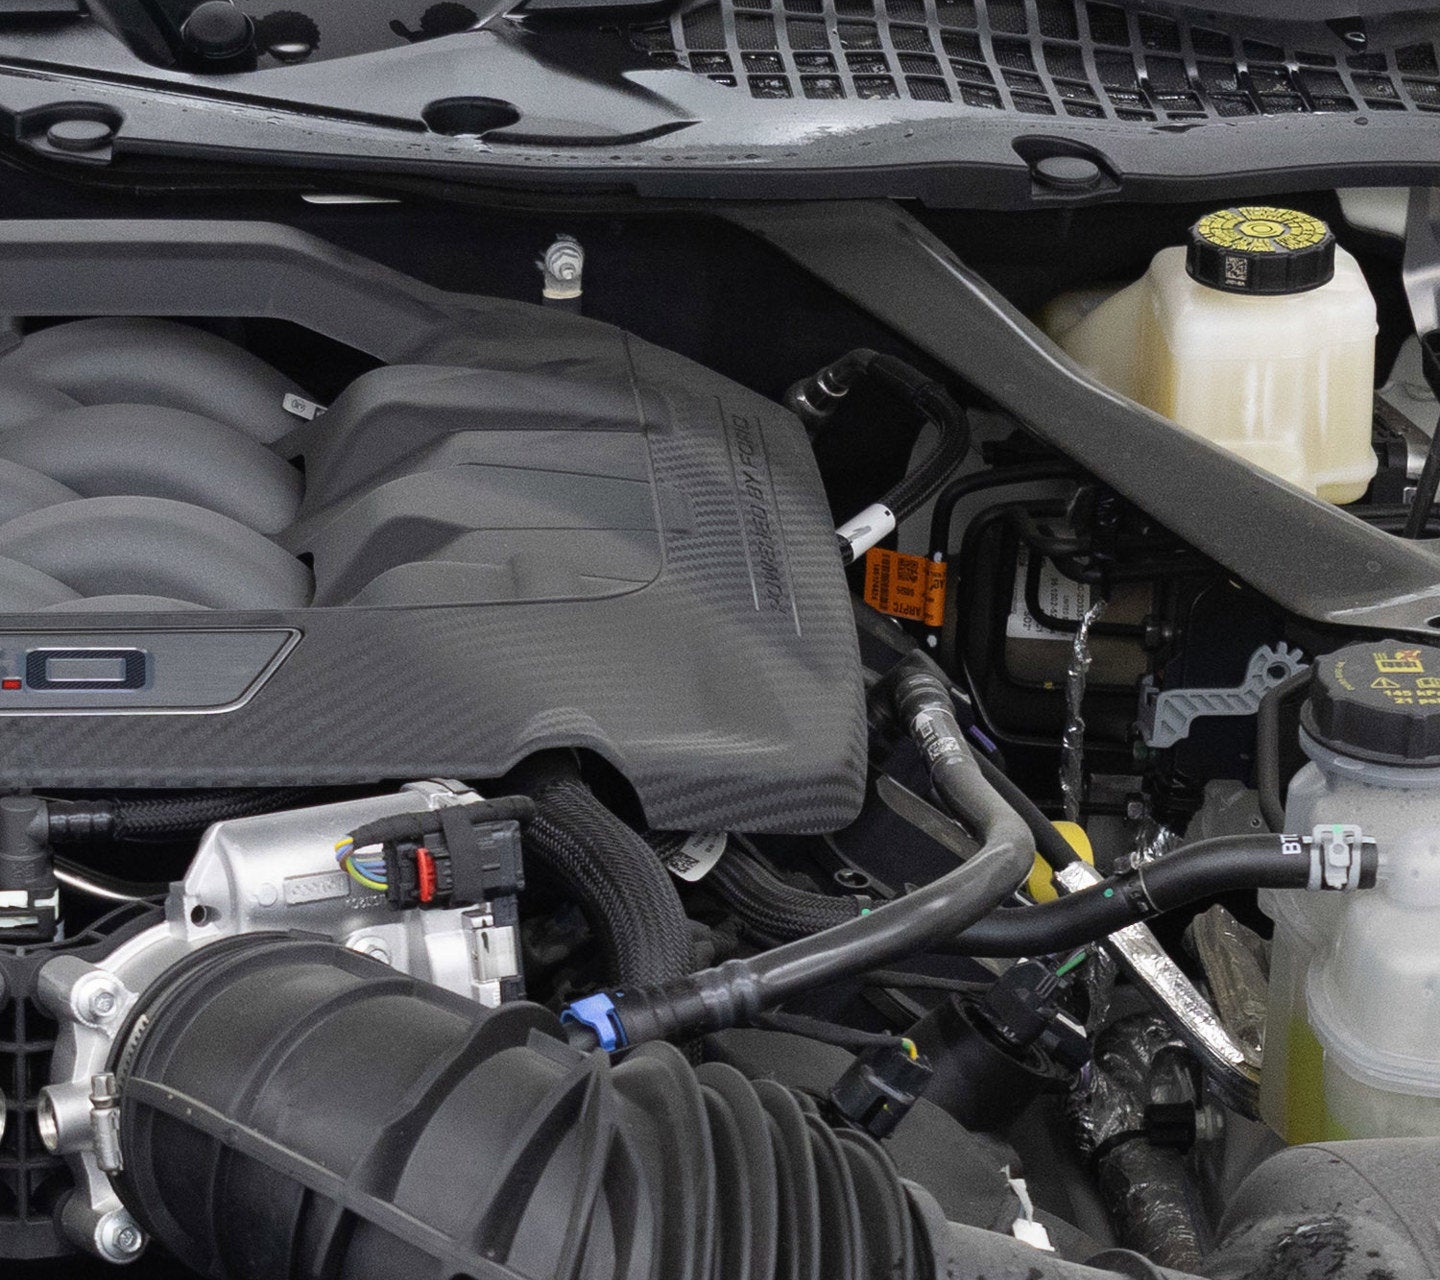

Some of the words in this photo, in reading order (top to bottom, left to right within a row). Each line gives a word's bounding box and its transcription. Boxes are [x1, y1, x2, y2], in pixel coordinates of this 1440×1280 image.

[731, 414, 758, 469] FORD
[742, 470, 764, 502] BY
[749, 506, 788, 615] POWERED
